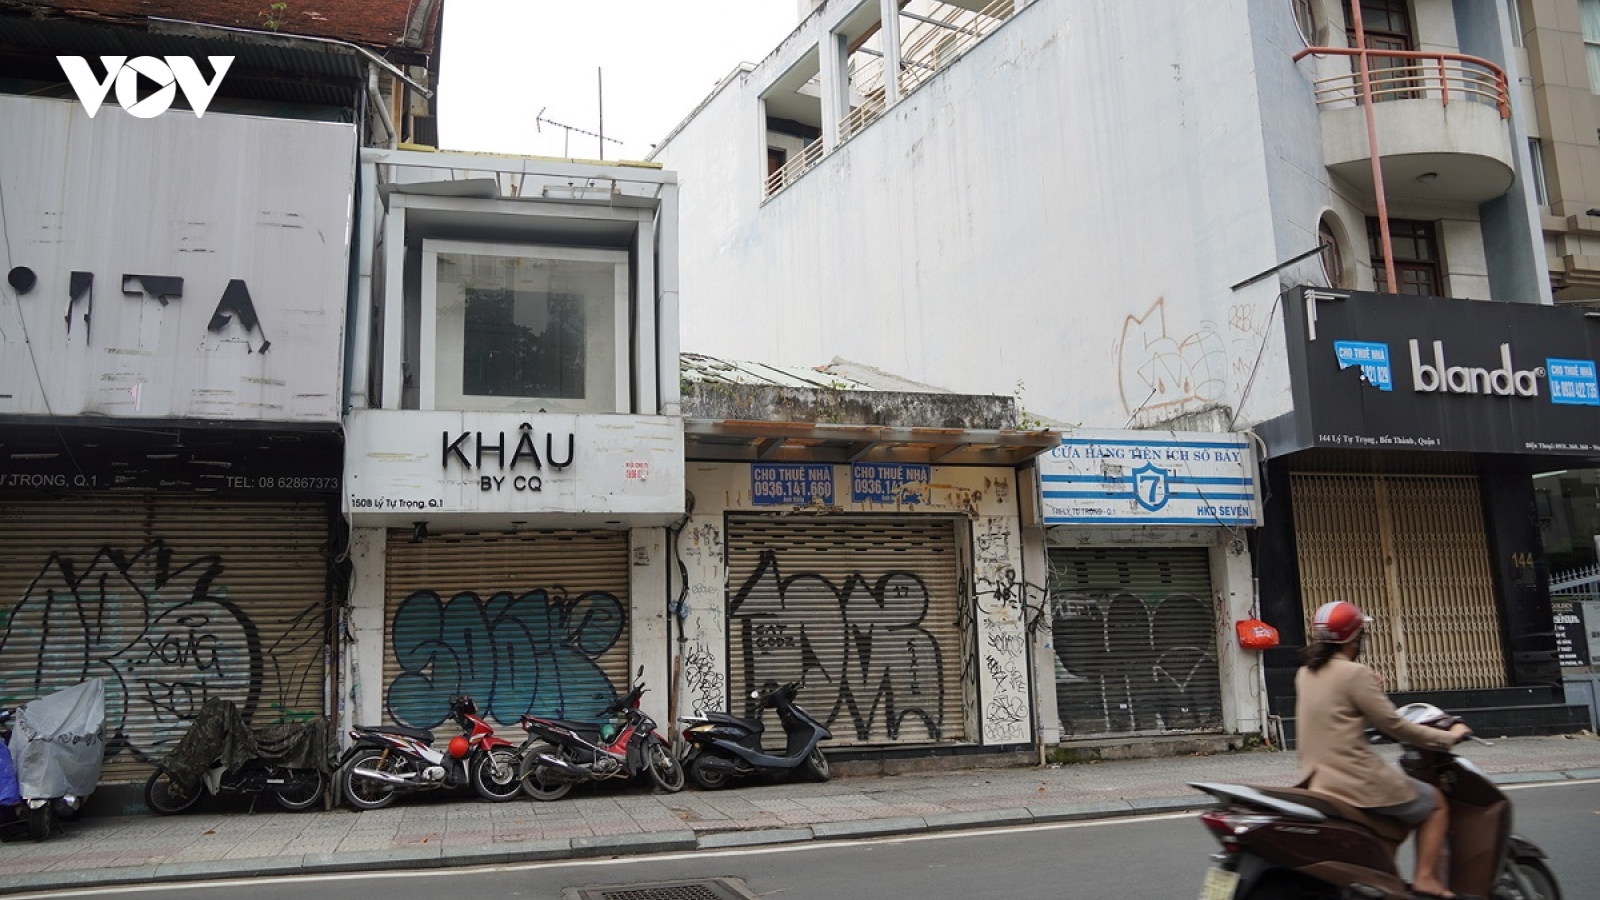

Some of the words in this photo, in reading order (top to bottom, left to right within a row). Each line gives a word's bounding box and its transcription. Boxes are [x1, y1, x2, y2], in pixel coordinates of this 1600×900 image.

[442, 422, 575, 471] KHÂU
[754, 468, 776, 480] CHO
[779, 467, 806, 480] THUÊ
[808, 467, 831, 480] NHÀ
[854, 466, 875, 478] CHO
[877, 466, 904, 479] THUÊ
[906, 467, 928, 480] NHÀ
[74, 474, 97, 487] Q.1
[226, 476, 255, 488] TEL:
[259, 477, 274, 488] 08
[278, 477, 338, 489] 62867373
[480, 475, 504, 491] BY
[514, 475, 543, 492] CQ
[754, 481, 832, 496] 0936.141.660
[1140, 476, 1160, 502] 7
[1219, 506, 1249, 516] SEVEN
[1511, 553, 1534, 568] 144
